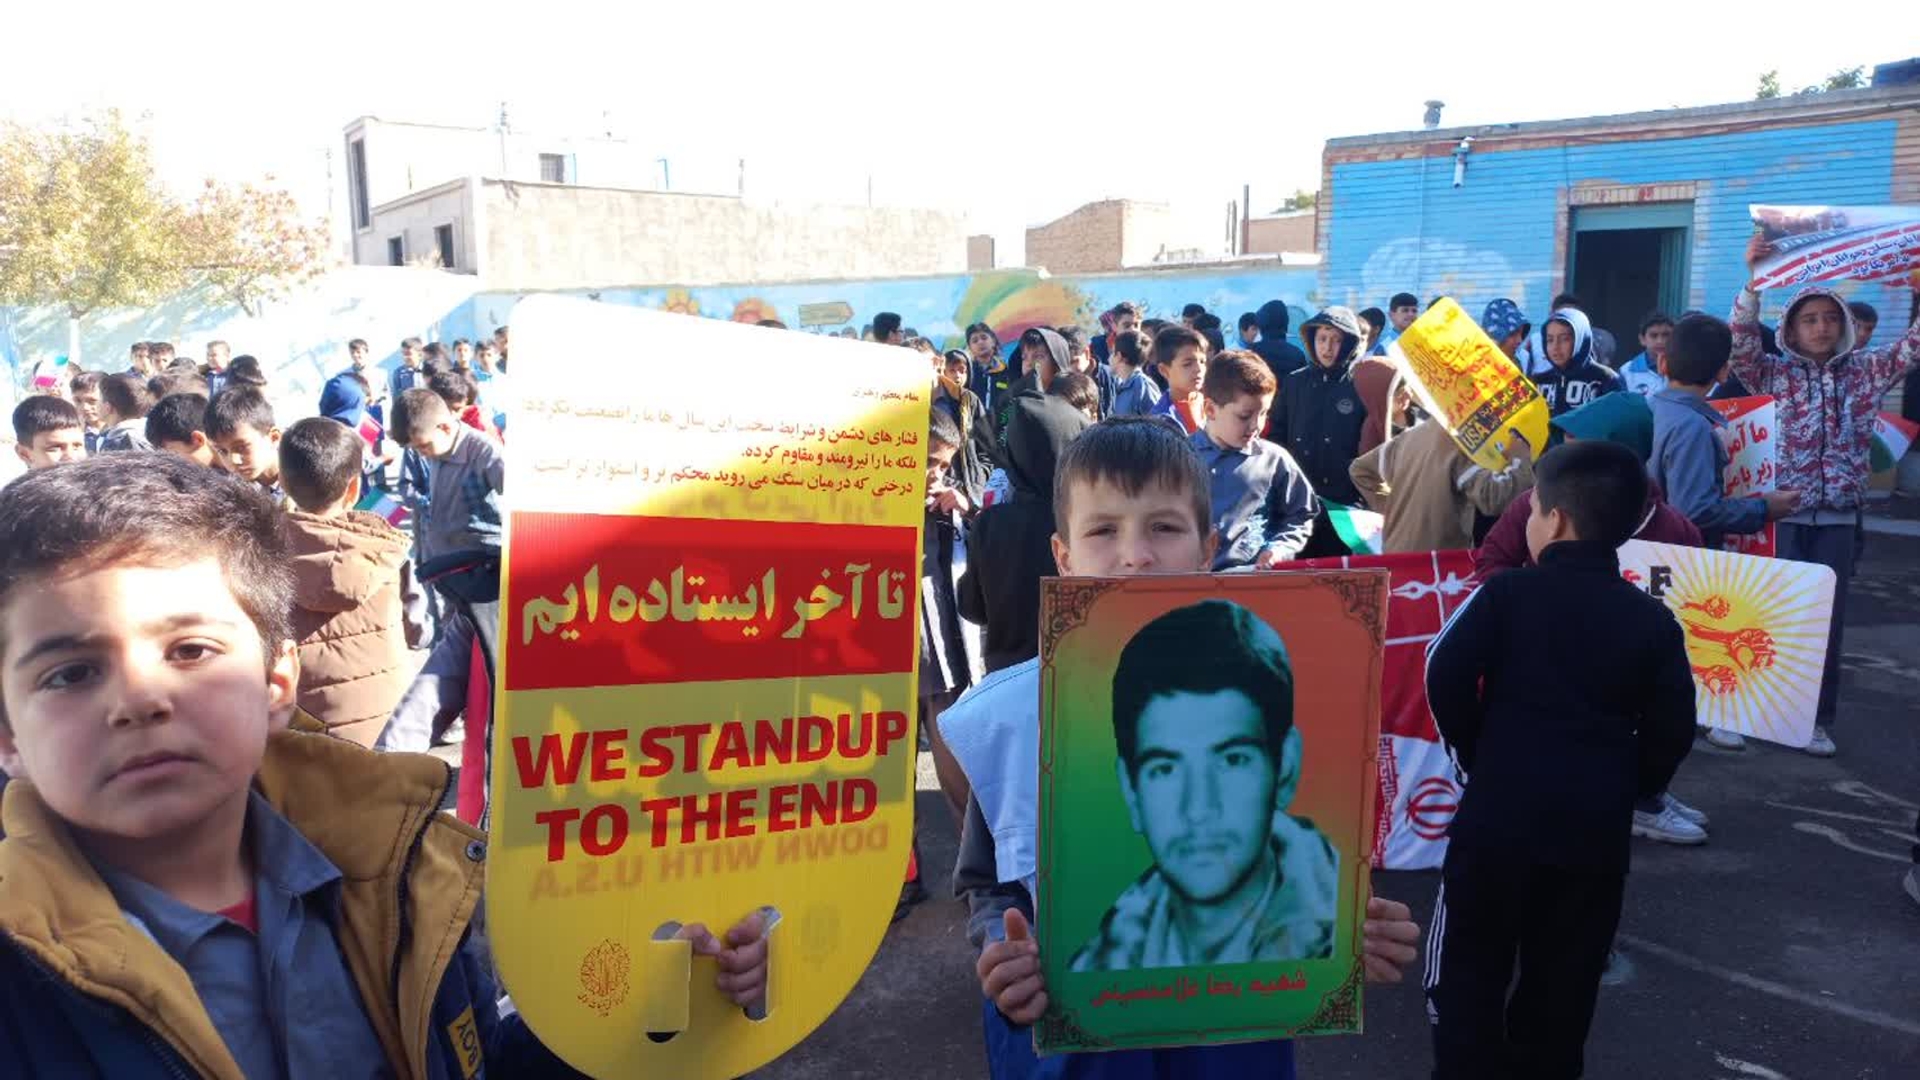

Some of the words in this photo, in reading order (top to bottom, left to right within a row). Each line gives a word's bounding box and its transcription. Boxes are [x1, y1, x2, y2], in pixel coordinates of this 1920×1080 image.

[779, 420, 816, 441] شرایط
[818, 427, 825, 441] و
[828, 427, 865, 443] دشمن
[867, 428, 892, 445] های
[895, 429, 918, 446] فشار
[1460, 425, 1487, 450] USA
[1750, 420, 1768, 443] ما
[781, 447, 815, 465] مقاوم
[815, 452, 824, 466] و
[826, 452, 869, 471] نیرومند
[871, 454, 881, 469] را
[883, 454, 893, 468] ما
[895, 455, 917, 469] بلکه
[641, 466, 650, 481] و
[670, 465, 711, 484] محکم
[714, 470, 746, 486] روید
[772, 470, 804, 486] سنگ
[1754, 457, 1773, 487] زیر
[748, 474, 769, 490] می
[807, 473, 834, 491] میان
[837, 479, 851, 493] در
[854, 476, 870, 490] که
[871, 480, 913, 497] درختی
[608, 564, 776, 637] ایستاده
[781, 562, 872, 639] آخر
[877, 568, 906, 620] تا
[521, 563, 600, 645] ایم
[512, 728, 629, 789] WE
[535, 803, 630, 863] TO
[640, 787, 758, 849] THE
[767, 777, 878, 833] END
[1206, 973, 1243, 998] رضا
[1250, 970, 1308, 998] شهید
